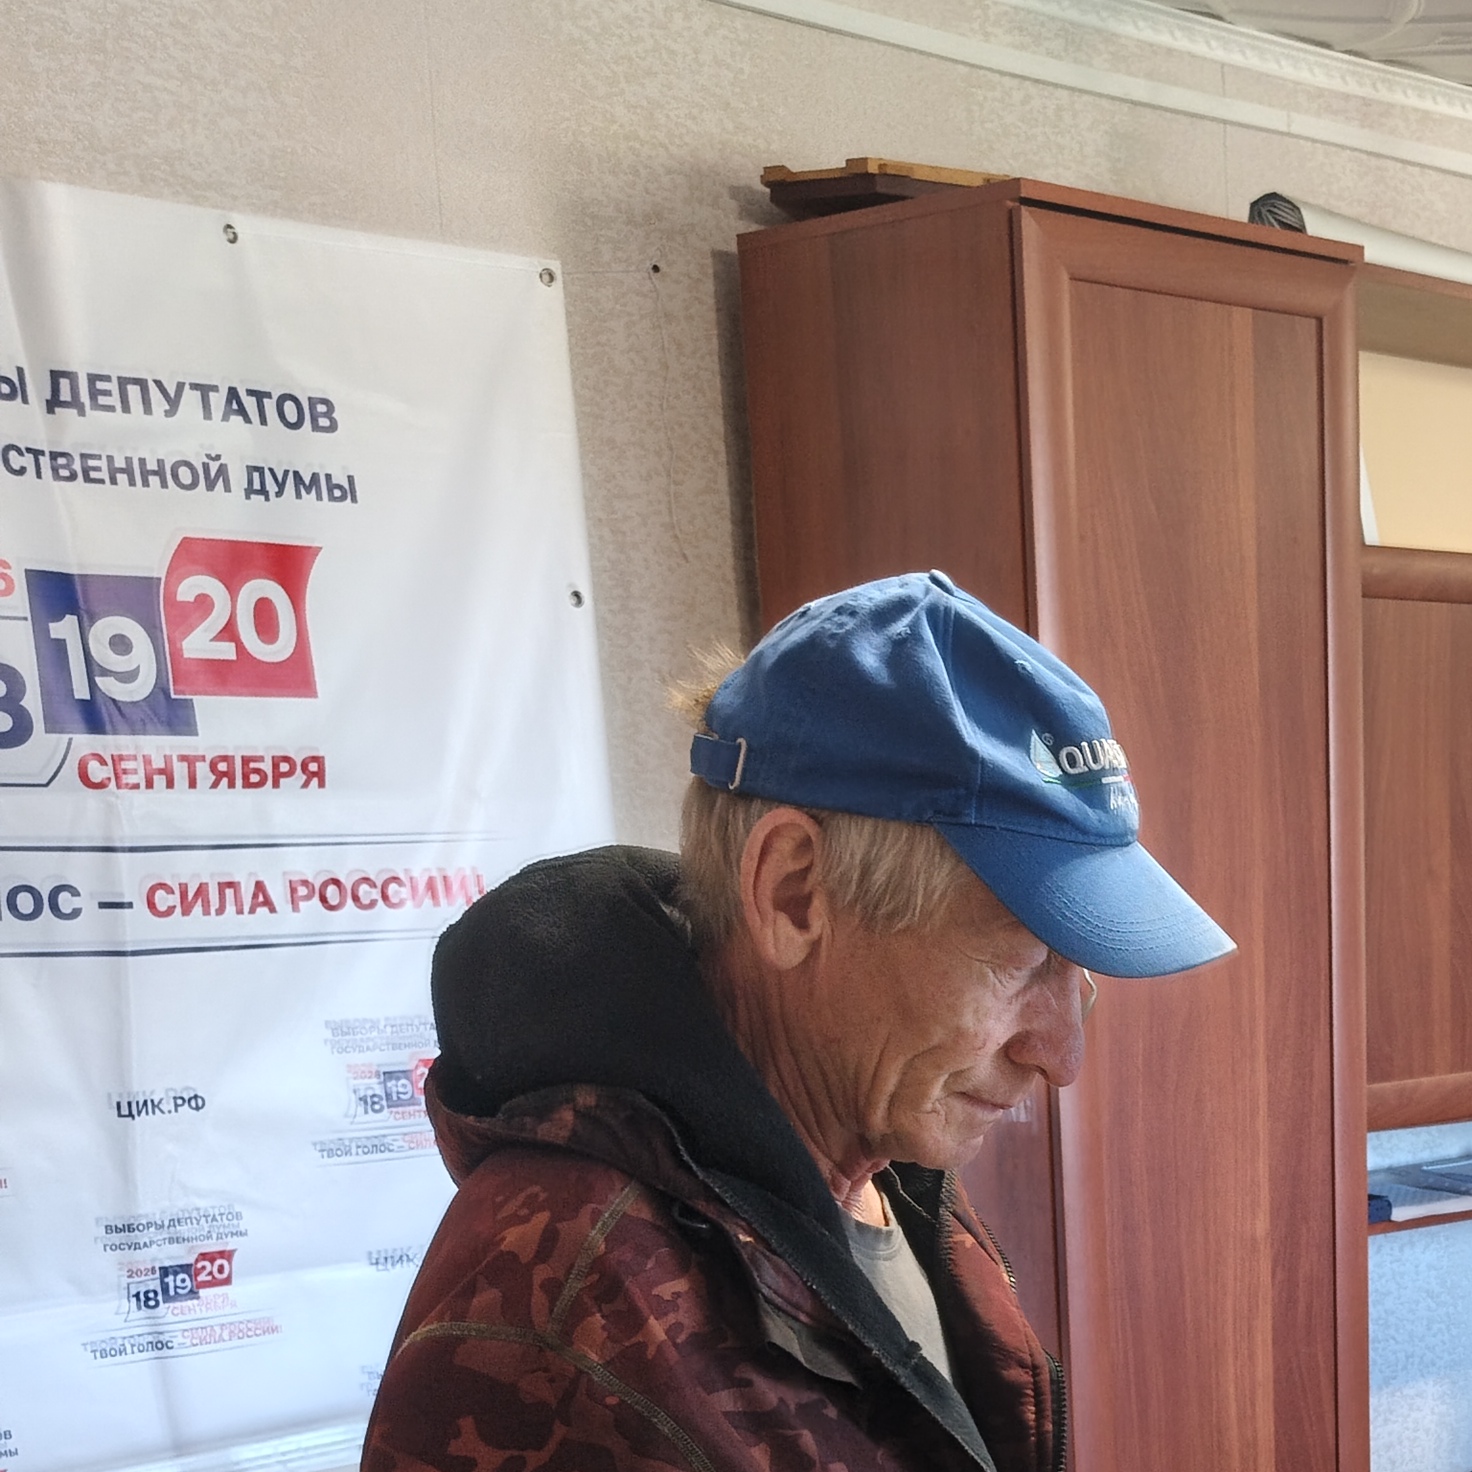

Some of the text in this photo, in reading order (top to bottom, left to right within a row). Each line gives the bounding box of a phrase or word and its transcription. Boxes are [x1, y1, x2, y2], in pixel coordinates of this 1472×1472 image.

[45, 369, 339, 434] ДЕПУТАТОВ
[0, 443, 358, 504] СТВЕННОЙ ДУМЫ
[176, 574, 297, 663] 20
[48, 614, 157, 702] 19
[78, 752, 326, 790] СЕНТЯБРЯ
[0, 884, 83, 922] ОС
[145, 879, 278, 918] СИЛА
[386, 1079, 413, 1101] 19
[116, 1093, 206, 1121] ЦИК.РФ
[358, 1094, 385, 1115] 18
[104, 1211, 244, 1235] ВЫБОРЫ ДЕПУТАТОВ
[103, 1228, 249, 1253] ГОСУДАРСТВЕННОЙ ДУМЫ
[126, 1266, 158, 1279] 2026
[196, 1258, 230, 1282] 20
[164, 1273, 192, 1296] 19
[132, 1289, 161, 1312] 18
[90, 1343, 128, 1361] ТВОЙ
[131, 1340, 175, 1355] ГОЛОС
